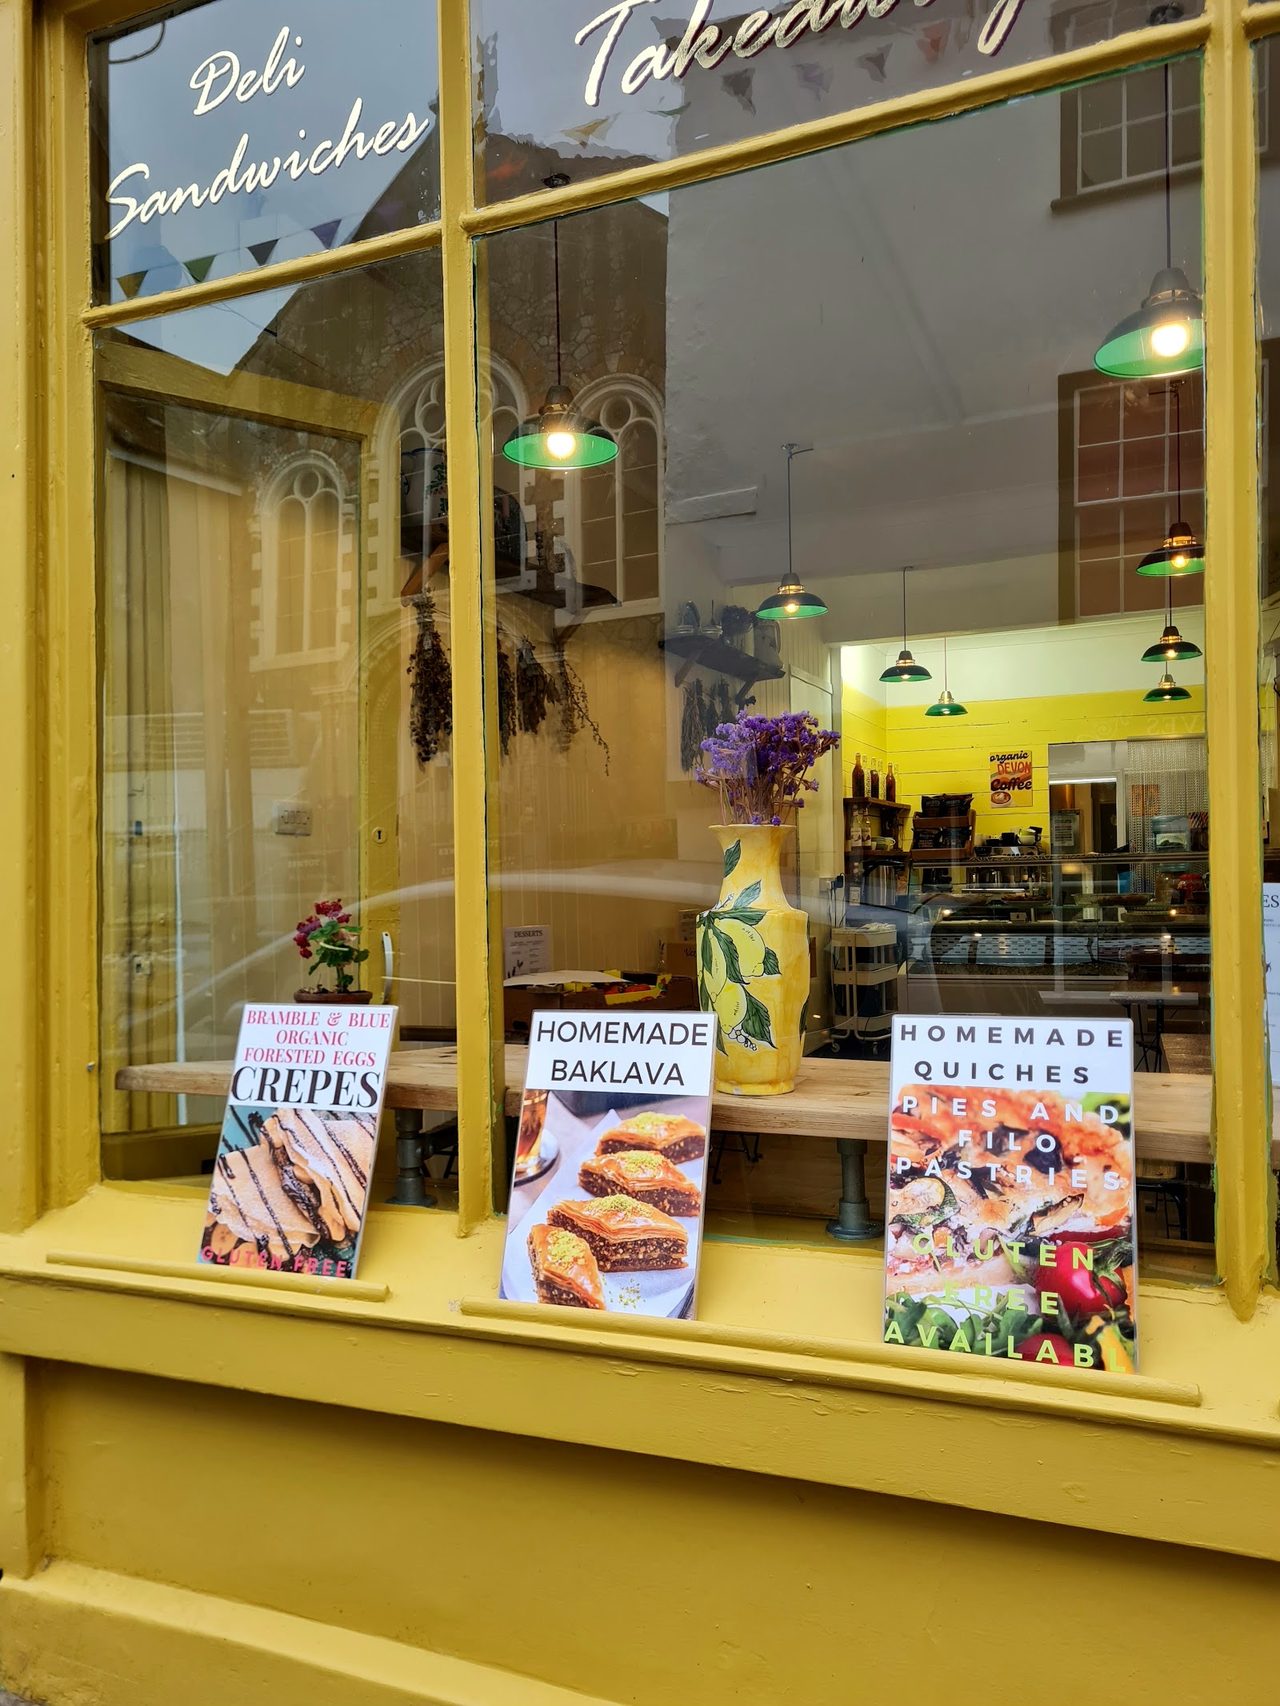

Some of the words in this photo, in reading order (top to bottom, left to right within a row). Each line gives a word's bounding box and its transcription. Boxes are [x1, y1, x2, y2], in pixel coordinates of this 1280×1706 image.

[575, 0, 1024, 106] Takeaw
[190, 25, 305, 116] Deli
[104, 97, 430, 240] Sandwiches
[989, 750, 1030, 764] organic
[996, 761, 1032, 775] DEVON
[990, 777, 1032, 791] Coffee
[514, 929, 543, 938] DESSERTS
[247, 1010, 320, 1026] BRAMBLE
[327, 1011, 342, 1027] &
[348, 1012, 390, 1028] BLUE
[276, 1029, 349, 1047] ORGANIC
[537, 1020, 709, 1046] HOMEMADE
[900, 1024, 1123, 1048] HOMEMADE
[244, 1047, 325, 1064] FORESTED
[333, 1050, 377, 1067] EGGS
[551, 1059, 685, 1086] BAKLAVA
[914, 1060, 1089, 1084] QUICHES
[231, 1066, 381, 1108] CREPES
[902, 1095, 997, 1118] PIES
[1030, 1102, 1119, 1124] AND
[958, 1129, 1056, 1153] FILO
[896, 1156, 1121, 1191] PASTRIES
[201, 1245, 283, 1270] GLUTEN
[294, 1254, 347, 1278] FREE
[911, 1233, 1094, 1271] GLUTEN
[944, 1282, 1059, 1315] FREE
[884, 1321, 1126, 1373] AVAILABL
